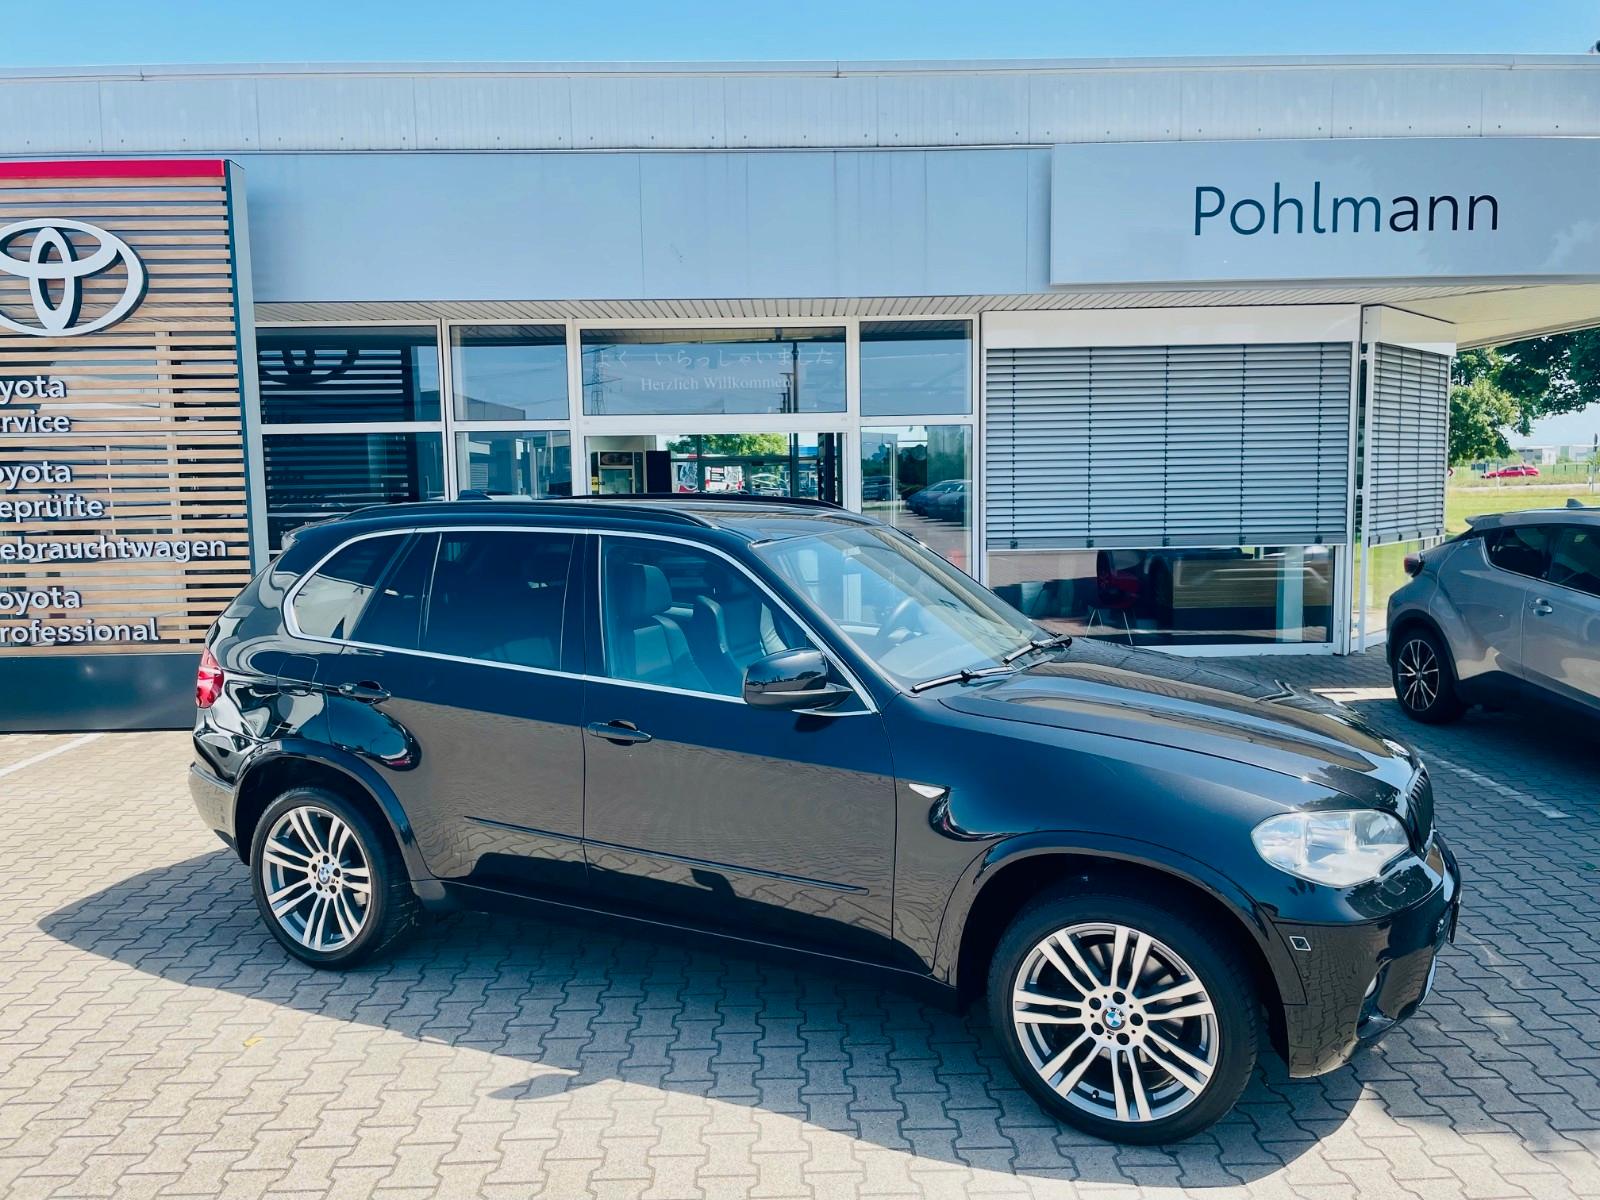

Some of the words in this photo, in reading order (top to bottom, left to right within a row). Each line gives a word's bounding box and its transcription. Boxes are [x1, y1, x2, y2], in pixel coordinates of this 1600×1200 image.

[1195, 181, 1498, 235] Pohlmann
[641, 376, 699, 391] Herzlich
[704, 375, 793, 390] Willkommen
